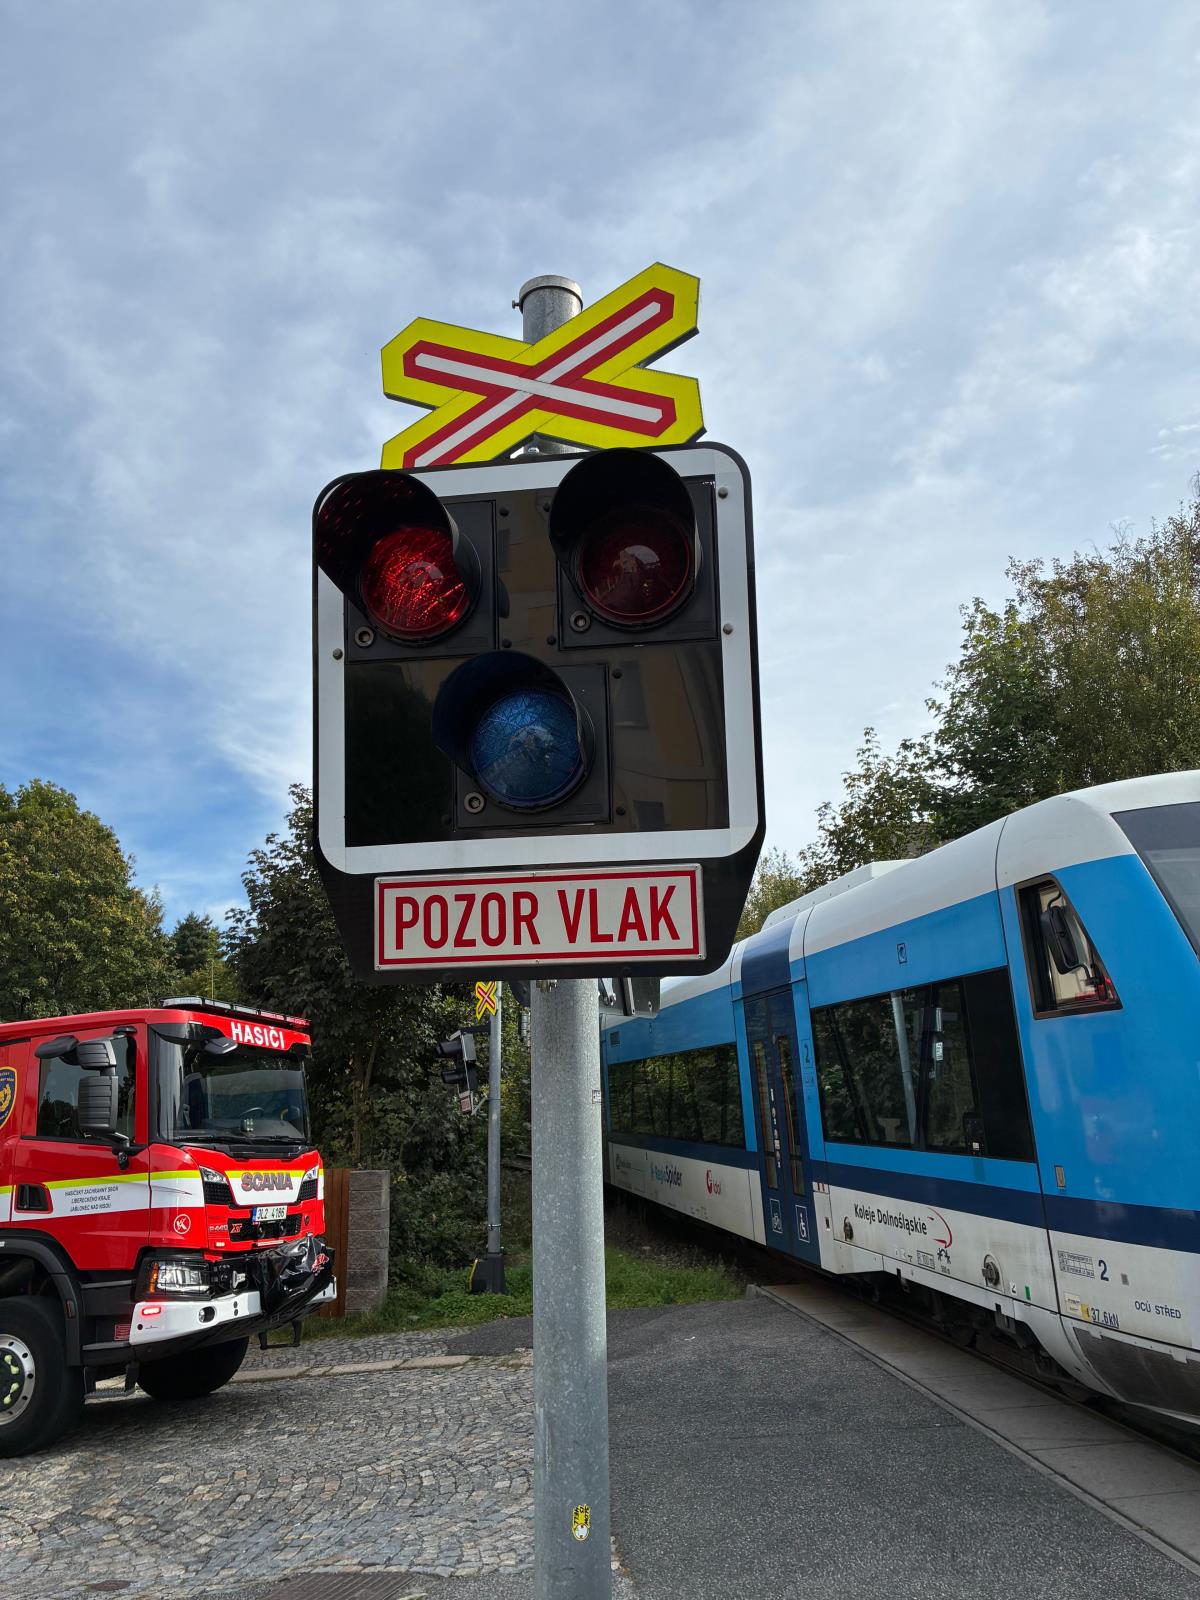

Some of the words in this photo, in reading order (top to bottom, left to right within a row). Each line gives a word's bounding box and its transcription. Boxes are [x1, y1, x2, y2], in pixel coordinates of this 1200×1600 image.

[395, 891, 540, 950] POZOR
[557, 885, 680, 943] VLAK
[230, 1021, 285, 1049] HASIČI
[241, 1172, 294, 1192] SCANIA
[854, 1203, 876, 1224] Koleje
[876, 1208, 928, 1236] Dolnośląskie
[1098, 1259, 1109, 1281] 2
[1155, 1304, 1181, 1319] STŘED
